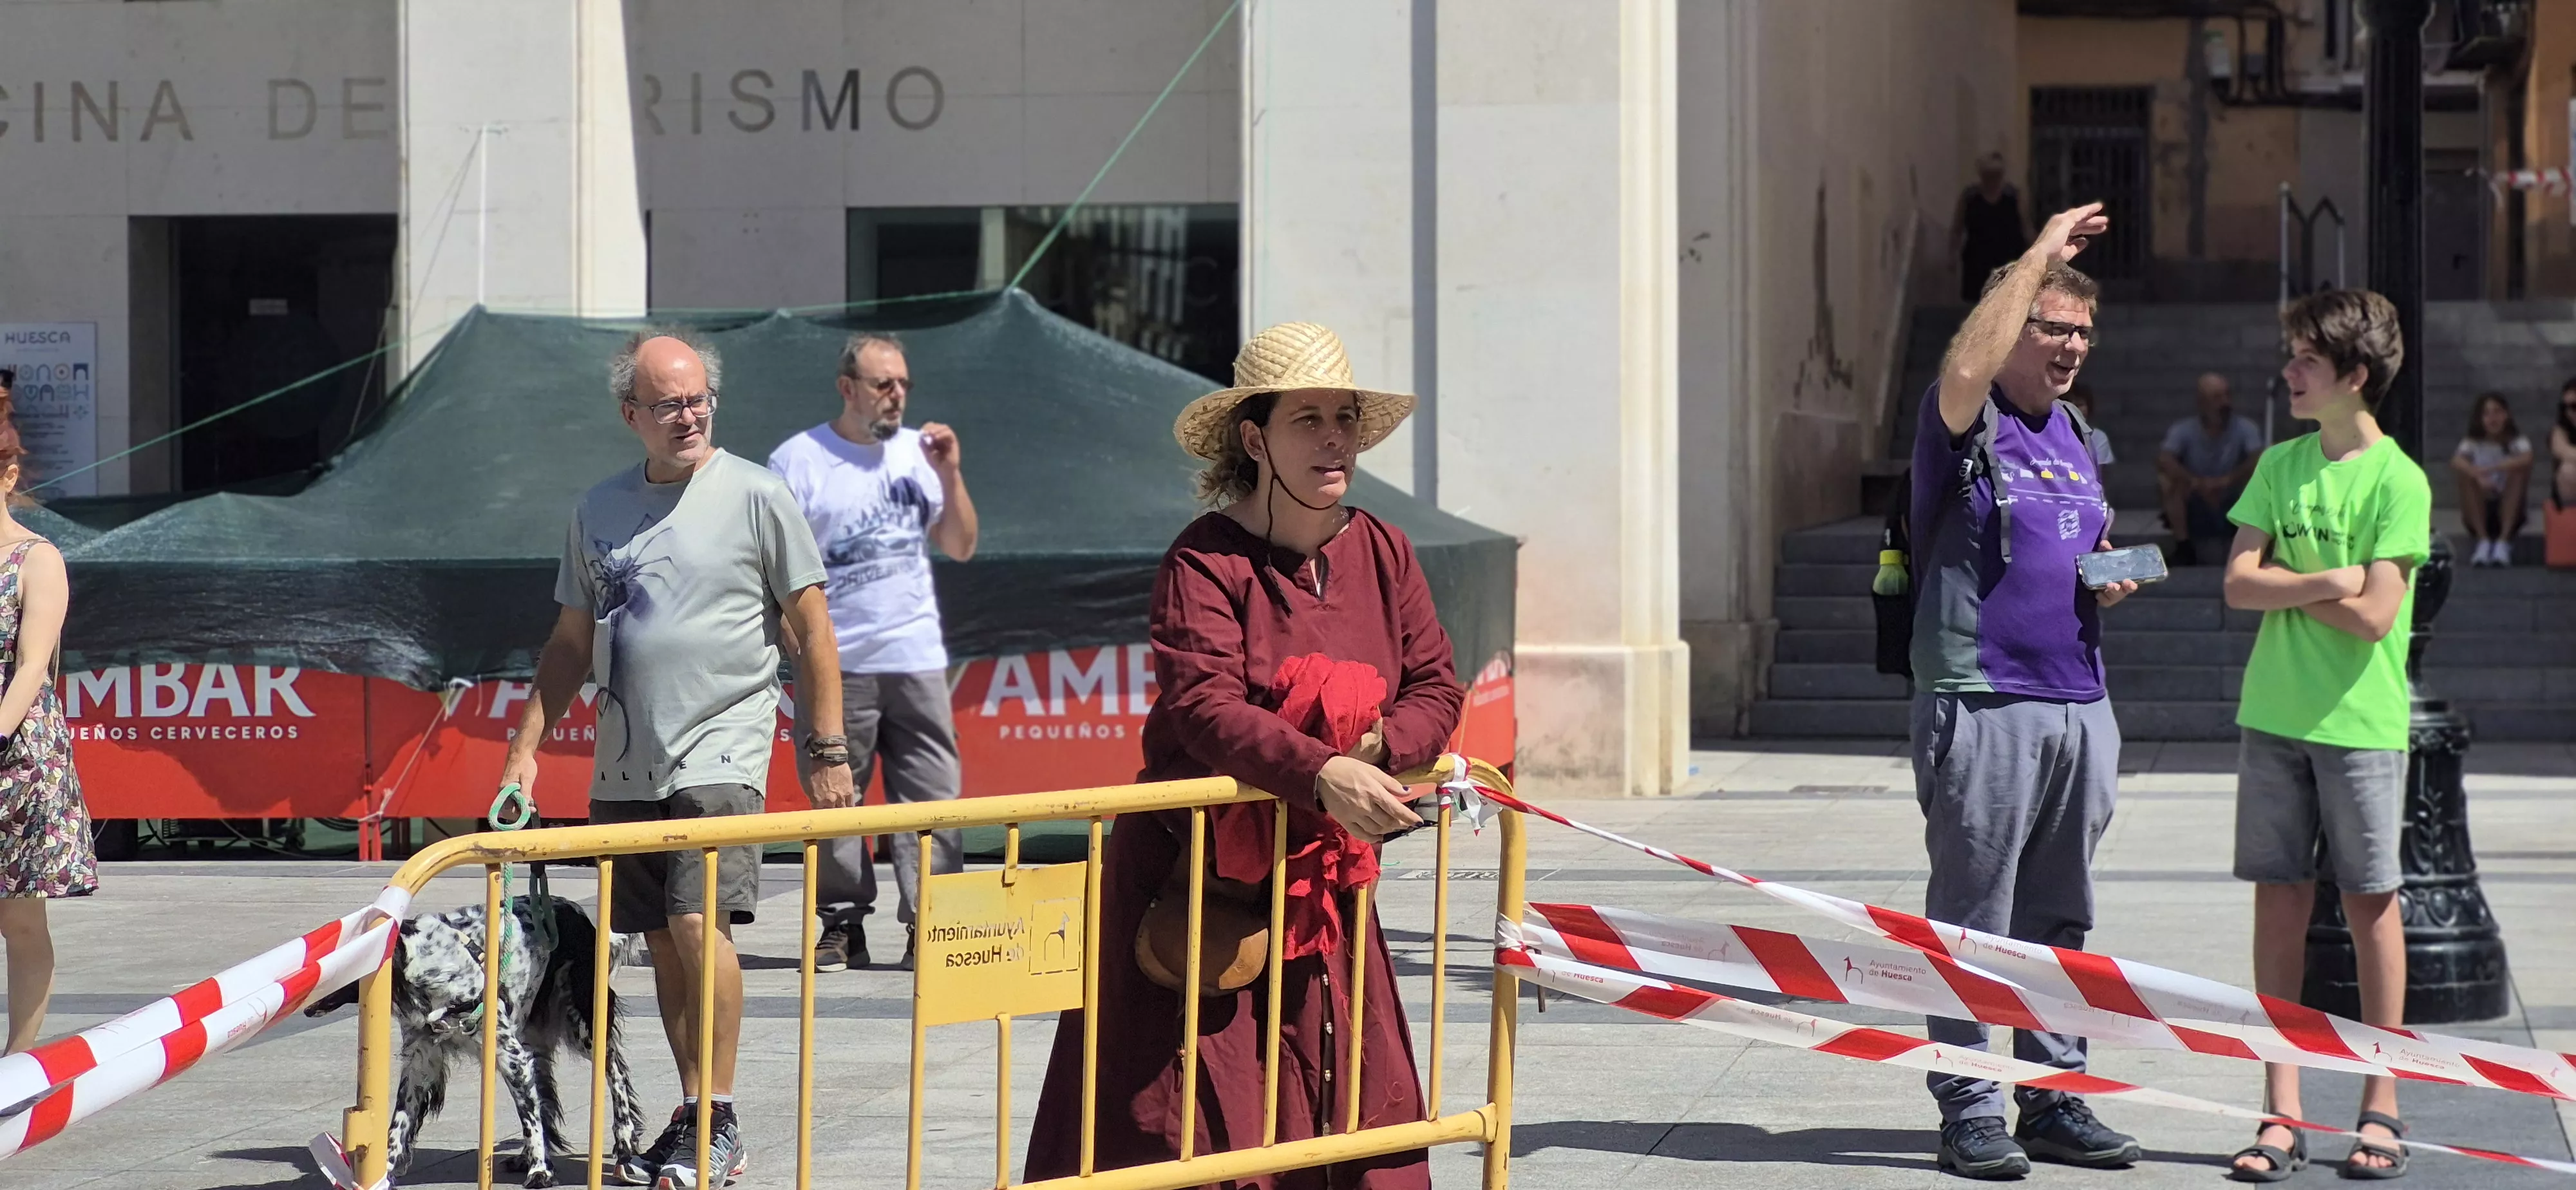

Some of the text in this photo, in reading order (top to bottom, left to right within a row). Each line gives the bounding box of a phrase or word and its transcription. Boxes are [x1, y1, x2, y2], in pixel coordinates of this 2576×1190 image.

[0, 66, 944, 143] INA DE RISMO
[5, 330, 71, 345] HUESCA
[150, 726, 298, 740] CERVECEROS
[1000, 722, 1126, 740] PEQUEÑOS
[1994, 945, 2027, 959] Huesca
[1870, 959, 1926, 975] Ayuntamiento
[1573, 972, 1604, 984] Huesca
[1869, 968, 1912, 981] de Huesca
[2412, 1058, 2445, 1070] Huesca
